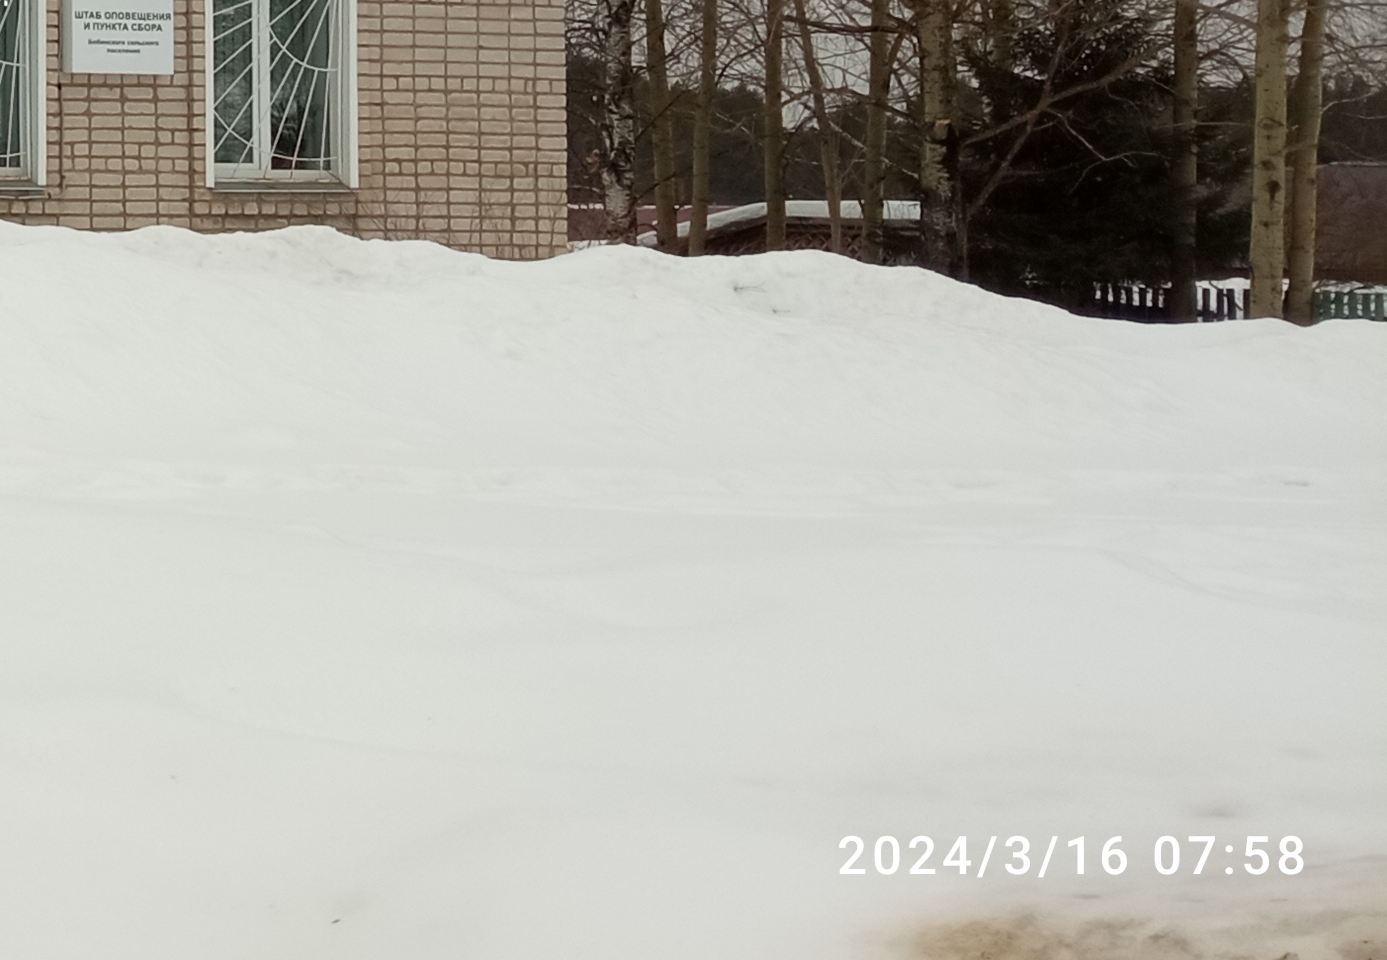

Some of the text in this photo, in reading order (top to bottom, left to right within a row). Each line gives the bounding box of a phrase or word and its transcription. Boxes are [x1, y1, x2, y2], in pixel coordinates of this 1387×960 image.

[74, 10, 172, 21] ШТАБ ОПОВЕЩЕНИЯ
[84, 22, 163, 32] И ПУНКТА СБОРА
